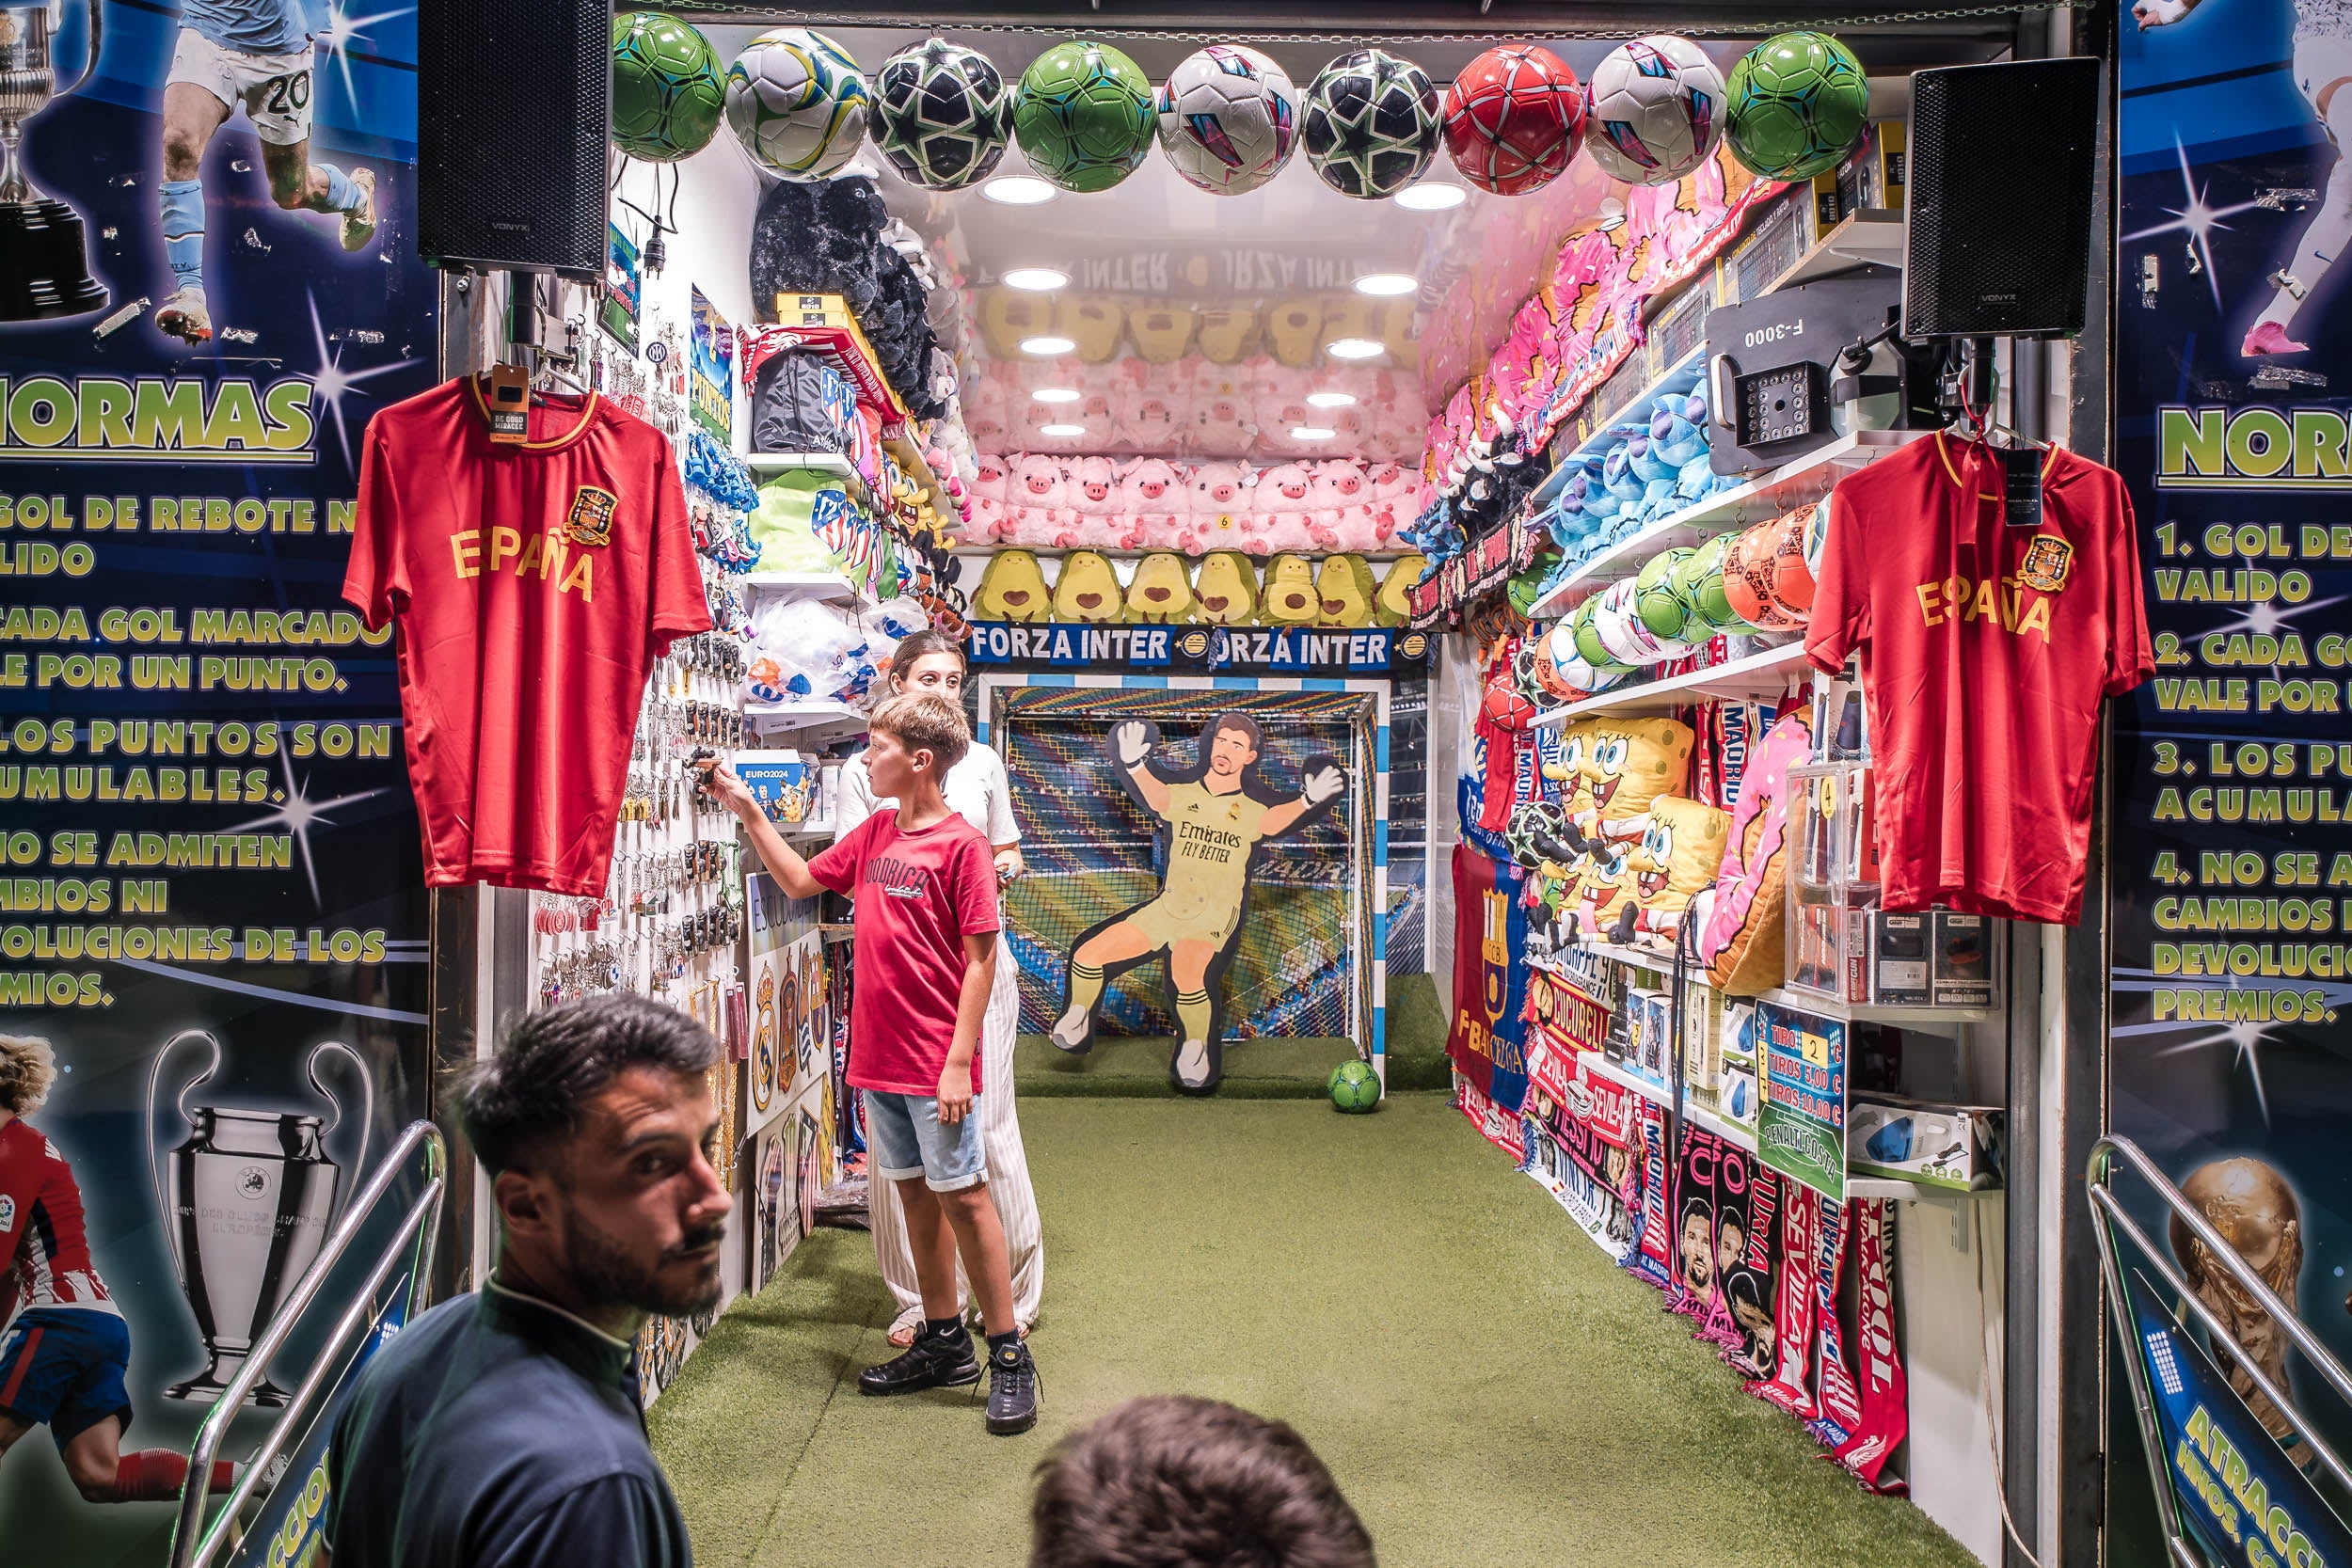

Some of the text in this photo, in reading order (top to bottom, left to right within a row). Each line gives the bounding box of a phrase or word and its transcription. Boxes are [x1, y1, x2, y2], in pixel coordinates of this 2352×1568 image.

[267, 71, 310, 114] 20
[492, 223, 527, 231] VONYX
[1981, 293, 2016, 302] VONYX
[1745, 320, 1804, 348] F-3000
[0, 378, 315, 451] ORMAS
[691, 366, 731, 433] PUNTOS
[495, 422, 524, 431] MIRACLE
[2162, 408, 2352, 478] NOR
[0, 496, 357, 532] GOL DE REBOTE N
[2154, 522, 2352, 558] 1. GOL DE
[0, 543, 95, 576] LIDO
[451, 526, 593, 603] EPAÑA
[2153, 570, 2311, 602] VALIDO
[0, 609, 392, 644] ADA GOL MARCADO
[972, 628, 1385, 664] FORZA INTER ORZA INTER
[2154, 633, 2352, 667] 2. CADA G
[39, 656, 122, 688] POR
[132, 657, 191, 689] UN
[201, 657, 348, 692] PUNTO.
[2153, 678, 2248, 712] VALE
[2259, 679, 2338, 713] POR
[90, 721, 279, 755] PUNTOS
[293, 723, 391, 757] SON
[1723, 706, 1744, 804] MADRID
[745, 770, 788, 780] EURO2024
[2153, 742, 2196, 775] 3.
[2211, 743, 2296, 775] LOS
[0, 767, 286, 802] UMULABLES.
[52, 833, 98, 866] SE
[106, 834, 292, 870] ADMITEN
[1180, 821, 1242, 847] Emirates
[1182, 842, 1231, 863] FLY BETTER
[2152, 852, 2192, 885] 4.
[2201, 852, 2265, 885] NO
[2274, 853, 2319, 886] SE
[122, 880, 168, 913] NI
[2153, 897, 2332, 931] CAMBIOS
[0, 926, 387, 962] OLUCIONES DE LOS
[2153, 943, 2352, 977] DEVOLUCI
[0, 973, 116, 1006] MIOS.
[1553, 987, 1605, 1053] CUCURELL
[2153, 990, 2338, 1025] PREMIOS.
[1771, 1025, 1796, 1049] TIRO
[1810, 1039, 1819, 1060] 2
[1834, 1044, 1842, 1063] €
[1769, 1053, 1801, 1080] TIROS
[1804, 1065, 1828, 1090] 5,00
[1833, 1076, 1841, 1096] €
[1594, 1085, 1624, 1128] SEVILLA
[1767, 1081, 1799, 1109] TIROS
[1801, 1095, 1830, 1121] 10,00
[1832, 1105, 1841, 1126] €
[1645, 1124, 1663, 1216] MADRID
[1764, 1123, 1837, 1184] PENALTI COSTA
[1649, 1259, 1669, 1281] MADRID
[1788, 1198, 1807, 1344] SEVILLA
[1760, 1384, 1792, 1407] SEVILL
[2177, 1440, 2241, 1544] HNOS.
